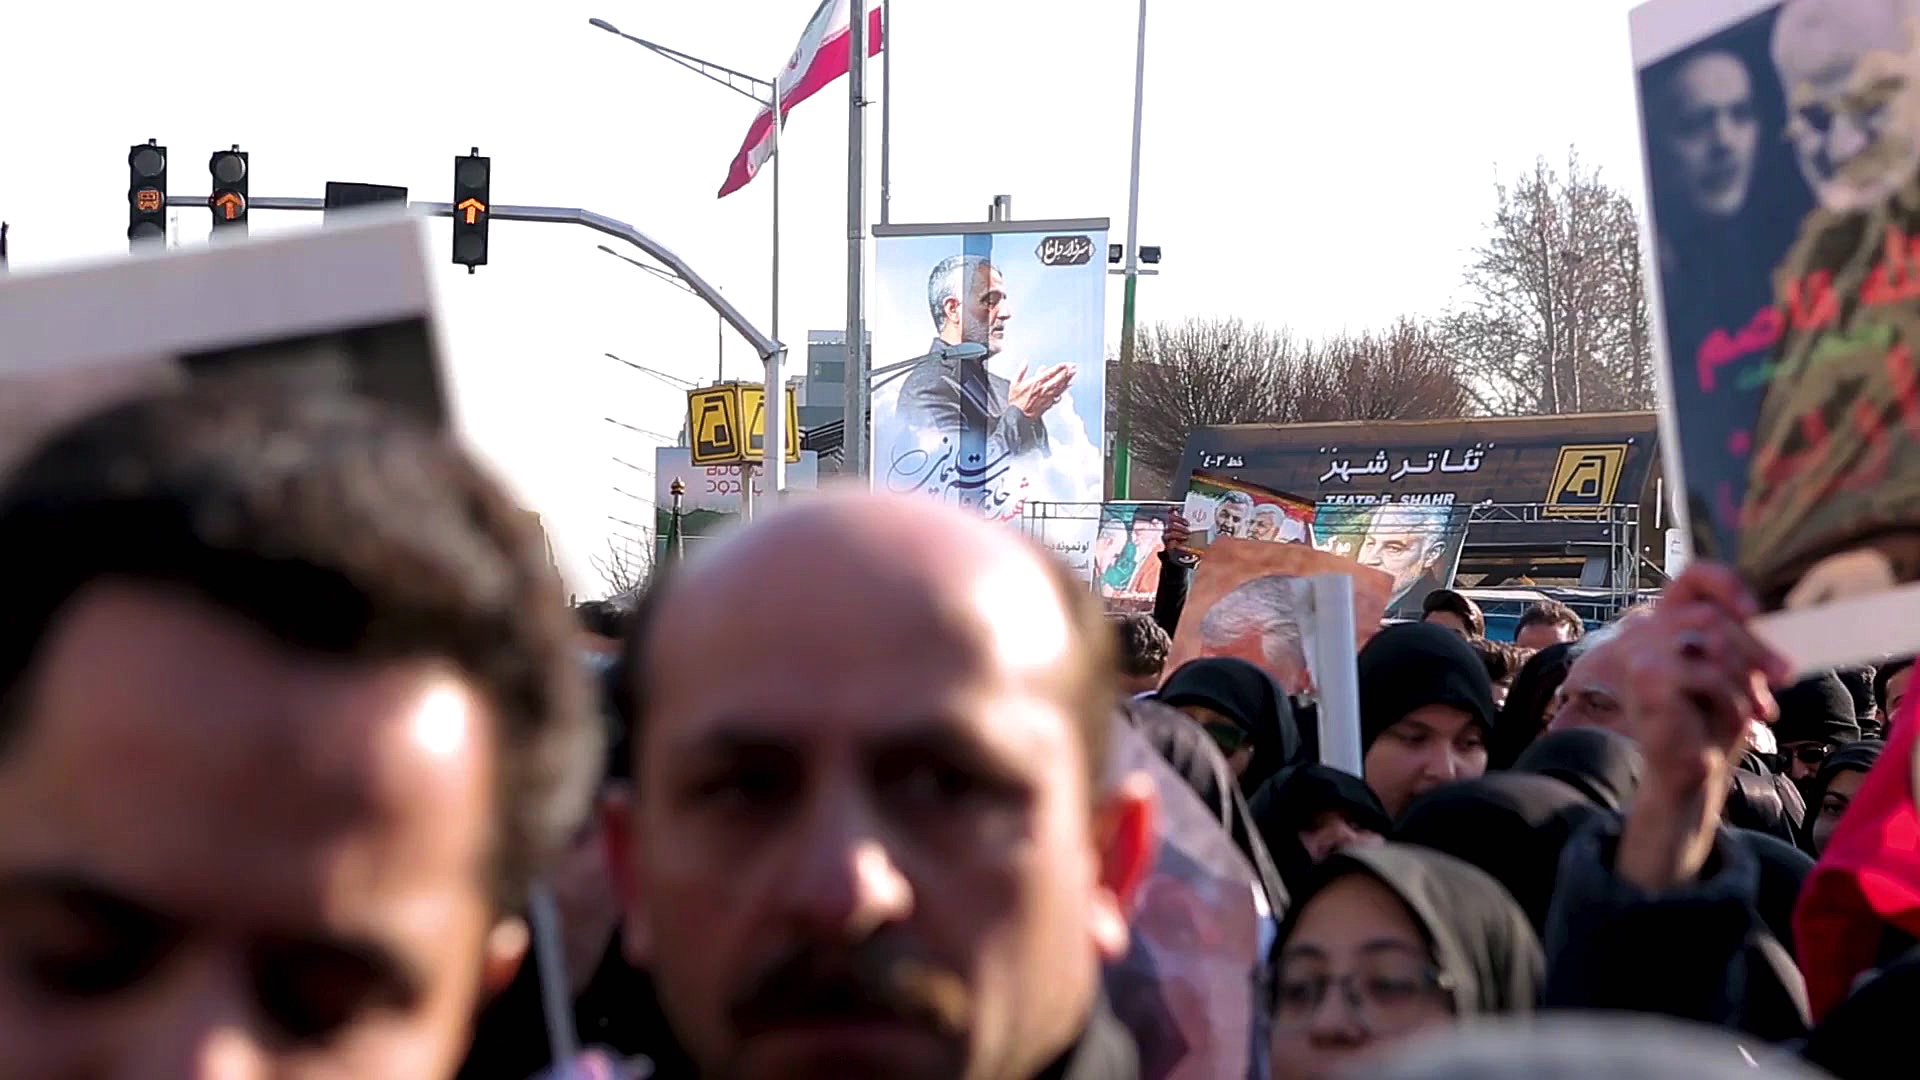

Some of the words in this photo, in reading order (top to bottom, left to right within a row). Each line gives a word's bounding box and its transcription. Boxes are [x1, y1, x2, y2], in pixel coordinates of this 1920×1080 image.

[1227, 455, 1243, 467] خط
[1320, 451, 1389, 482] شهر
[1391, 449, 1483, 481] تئاتر
[1401, 493, 1456, 507] SHAHR
